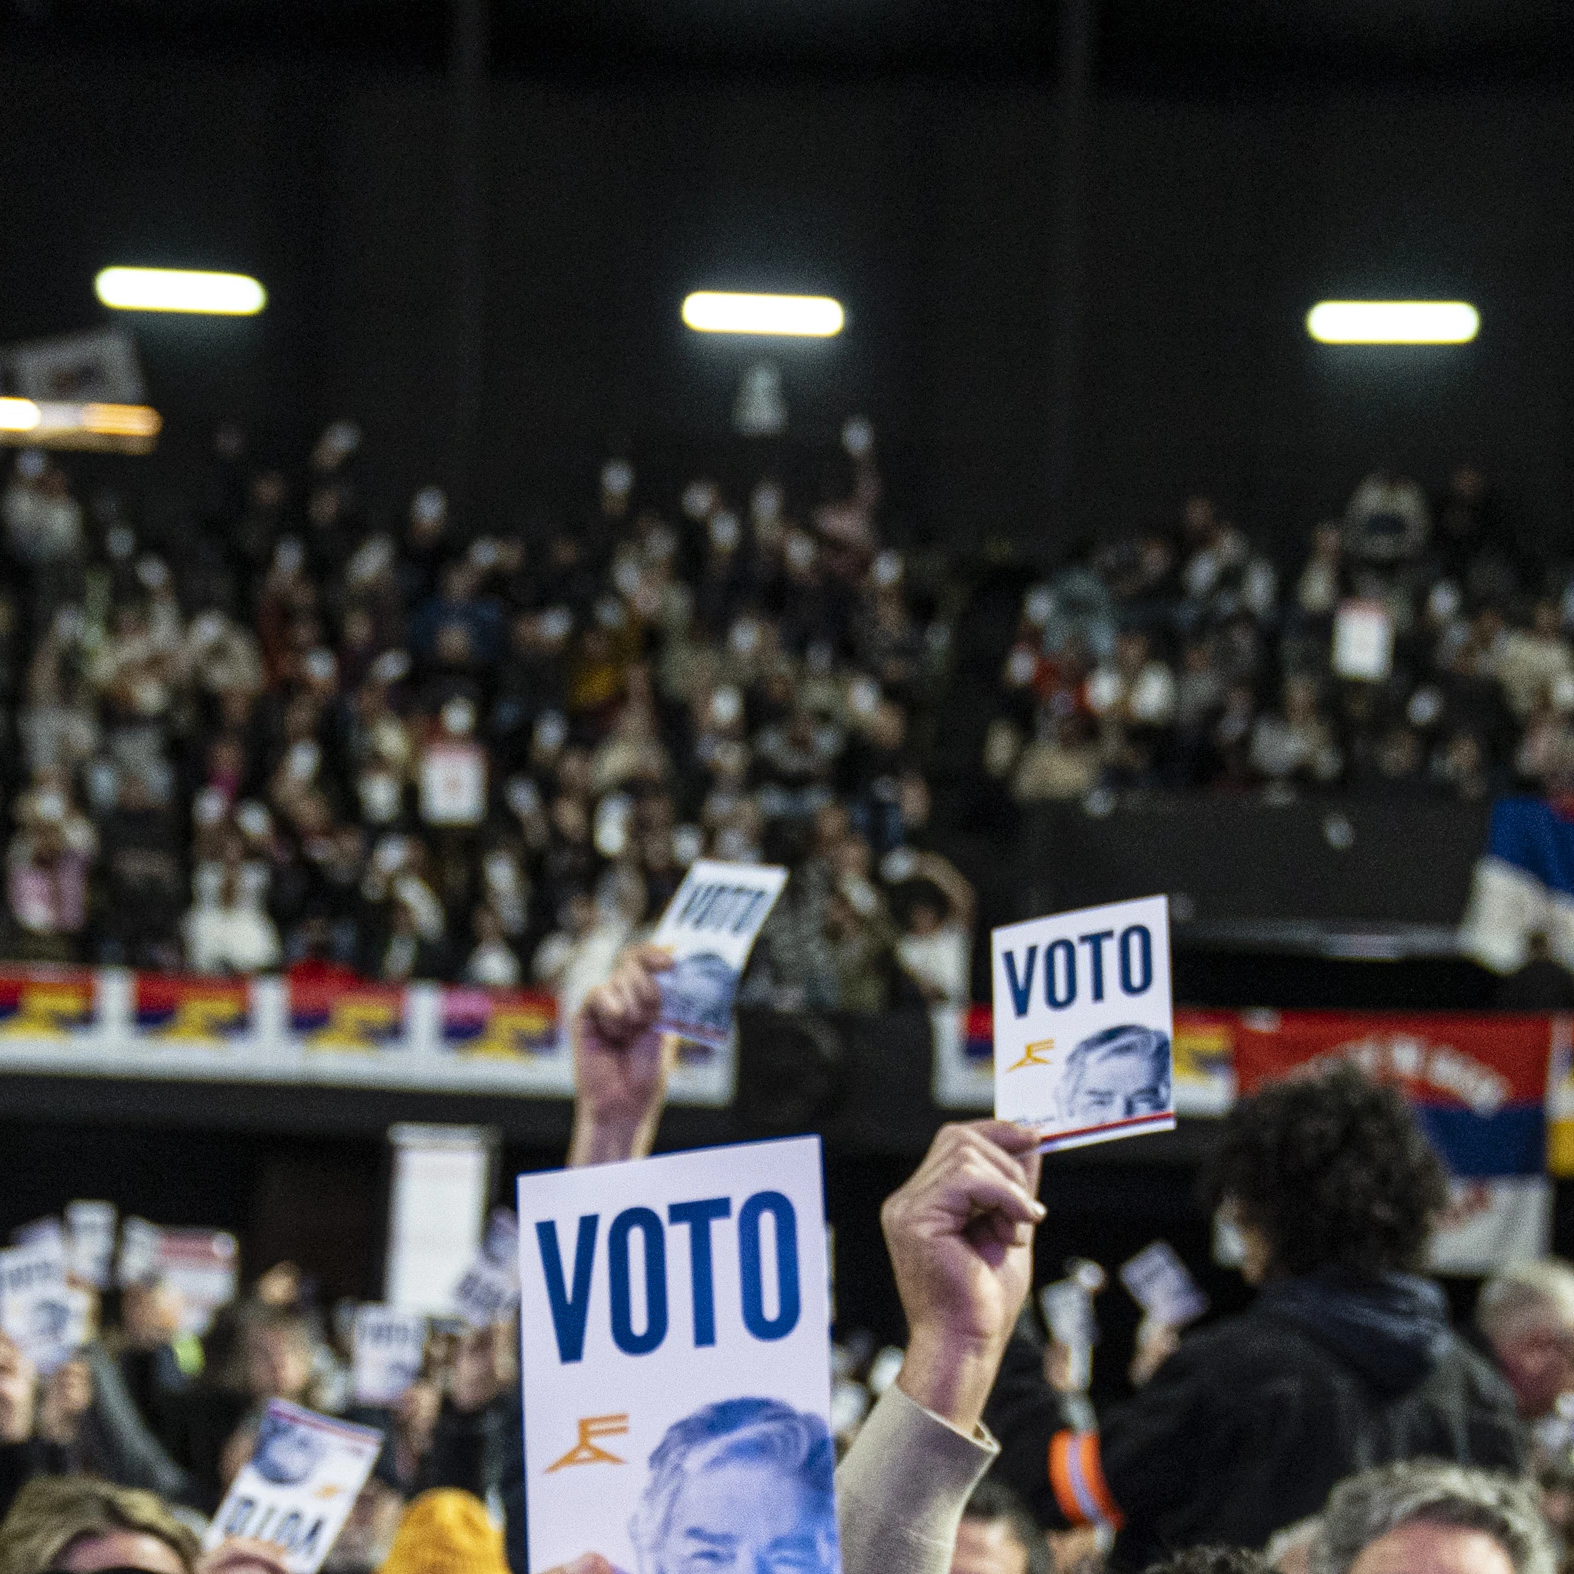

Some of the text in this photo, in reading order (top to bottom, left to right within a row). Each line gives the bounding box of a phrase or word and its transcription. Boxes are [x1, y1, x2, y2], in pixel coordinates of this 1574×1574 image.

[678, 883, 766, 936] VOTO
[1001, 923, 1153, 1019] VOTO
[535, 1190, 802, 1366] VOTO
